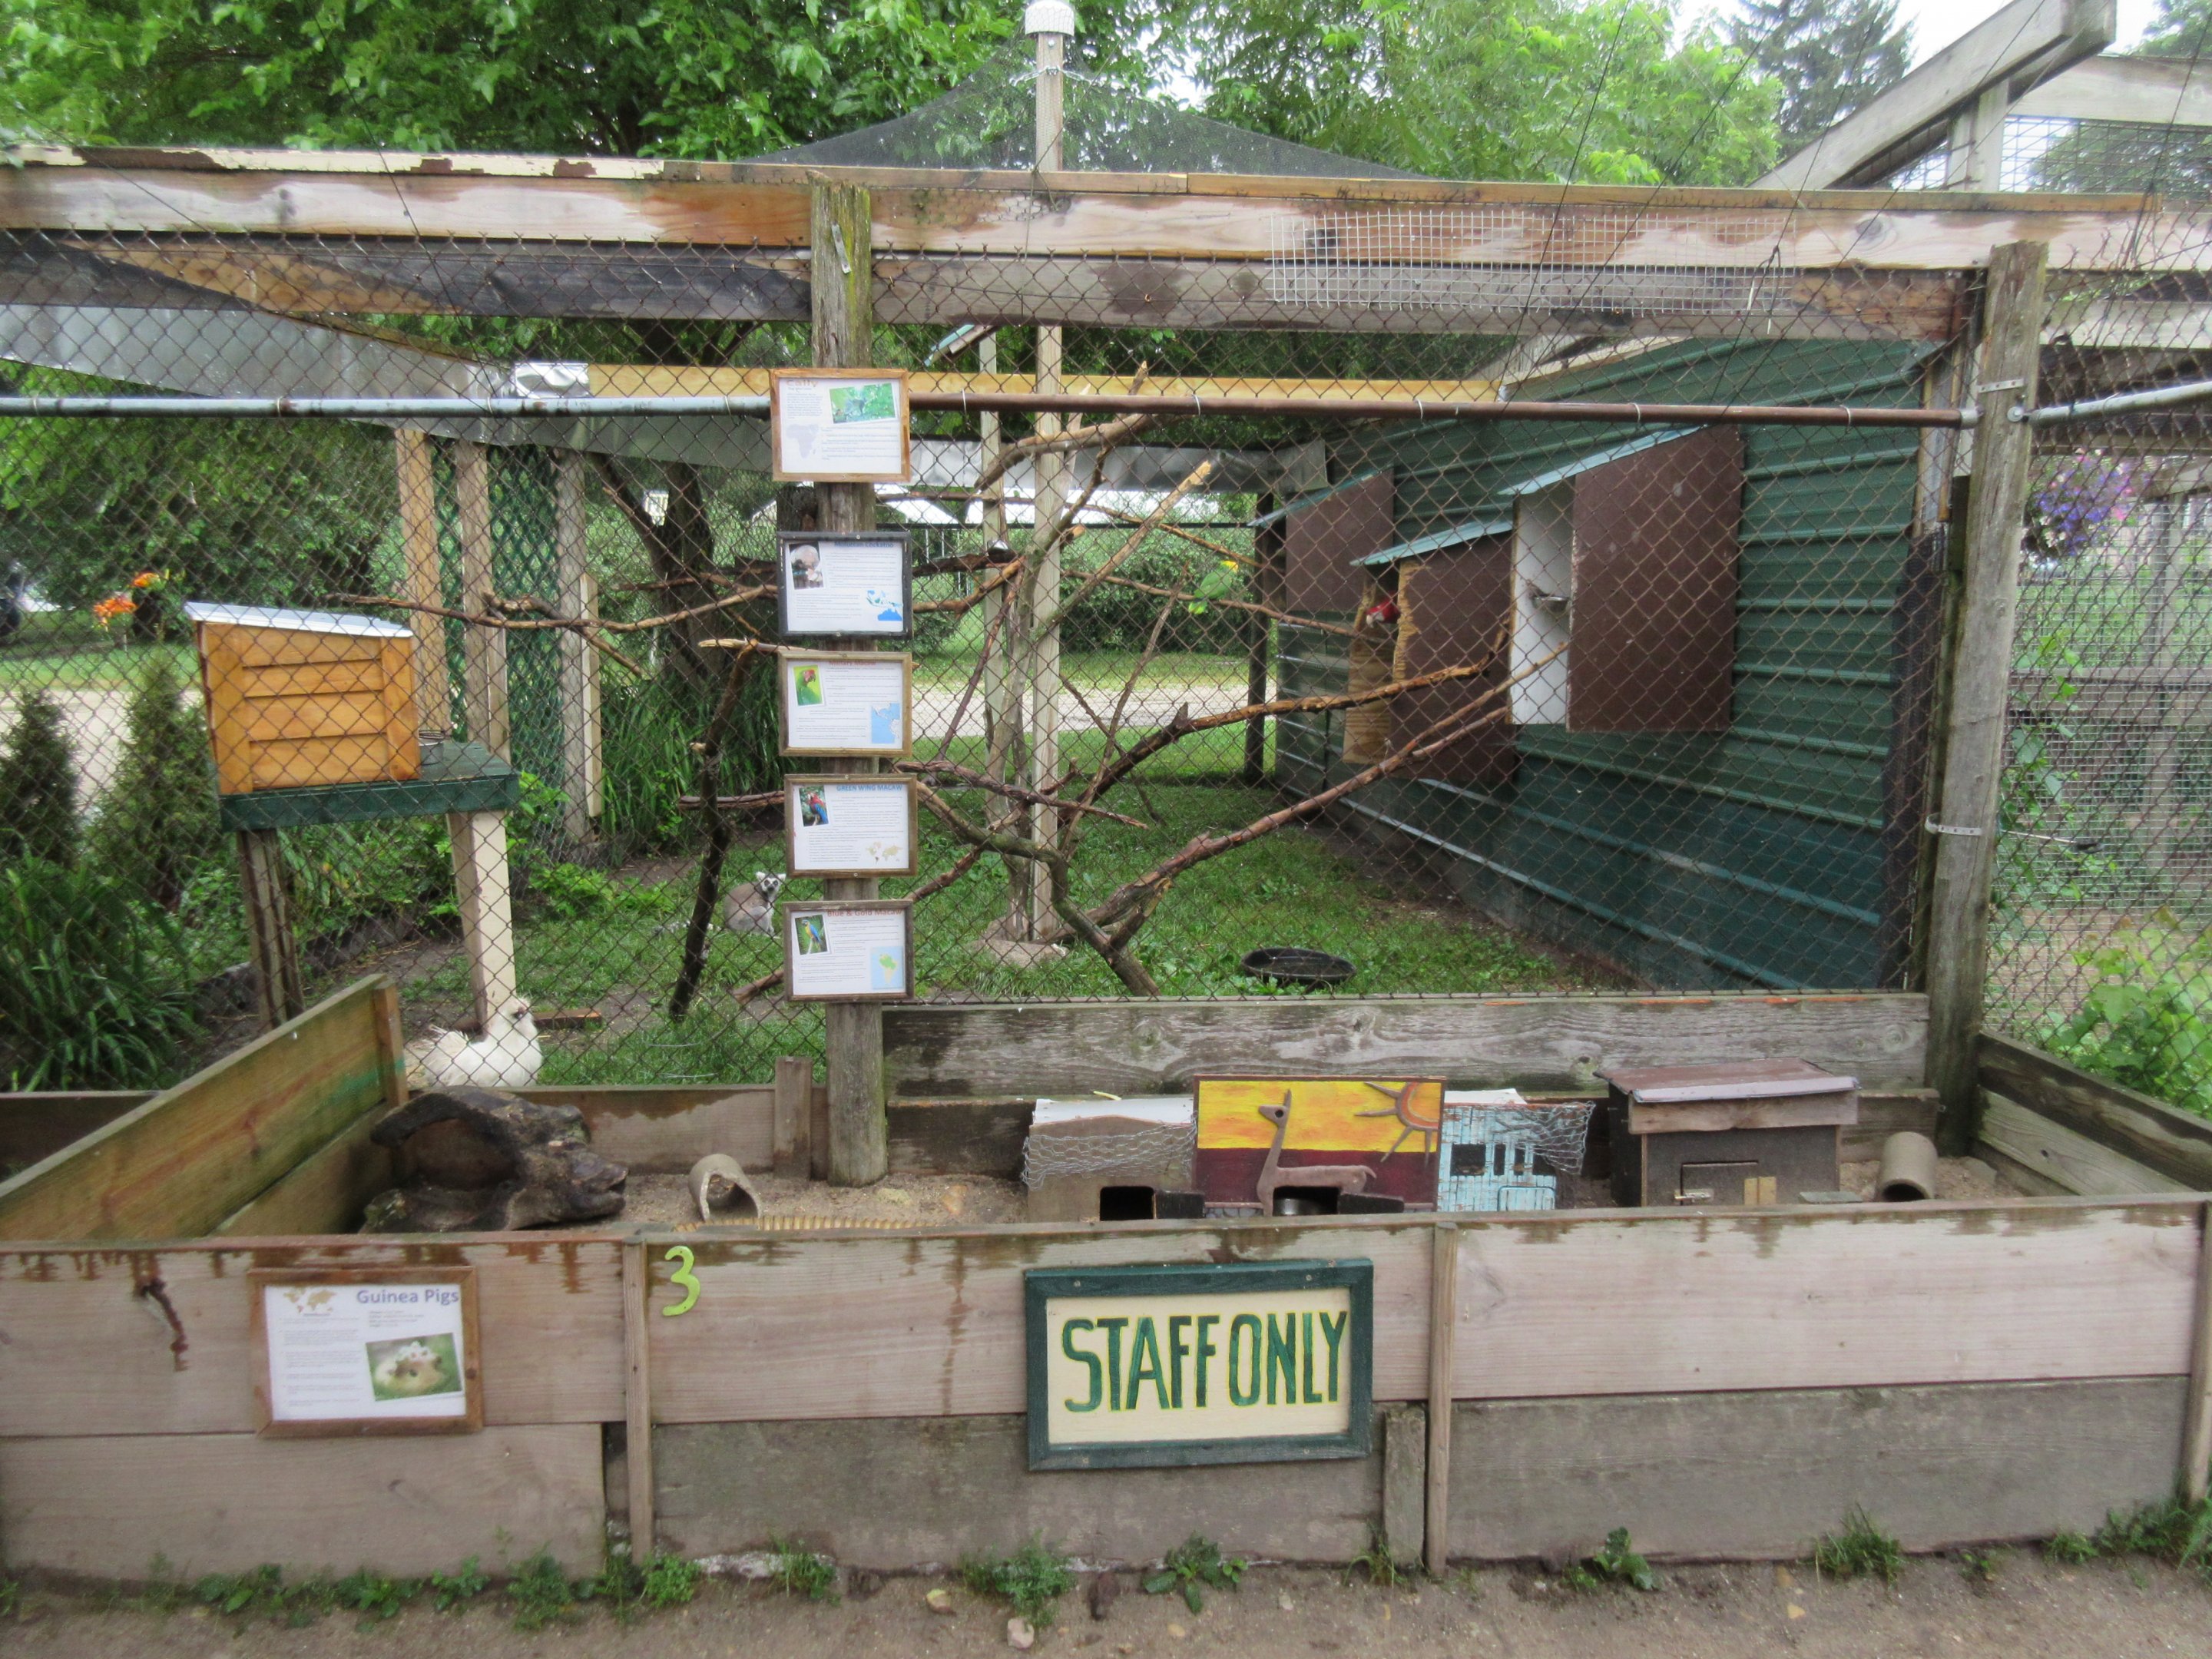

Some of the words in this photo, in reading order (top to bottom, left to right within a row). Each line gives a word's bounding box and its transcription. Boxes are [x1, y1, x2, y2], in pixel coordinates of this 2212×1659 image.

[356, 1290, 419, 1304] Guinea
[425, 1288, 459, 1306] Pigs
[662, 1245, 700, 1316] 3
[1061, 1313, 1220, 1413] STAFF
[1229, 1310, 1347, 1407] ONLY
